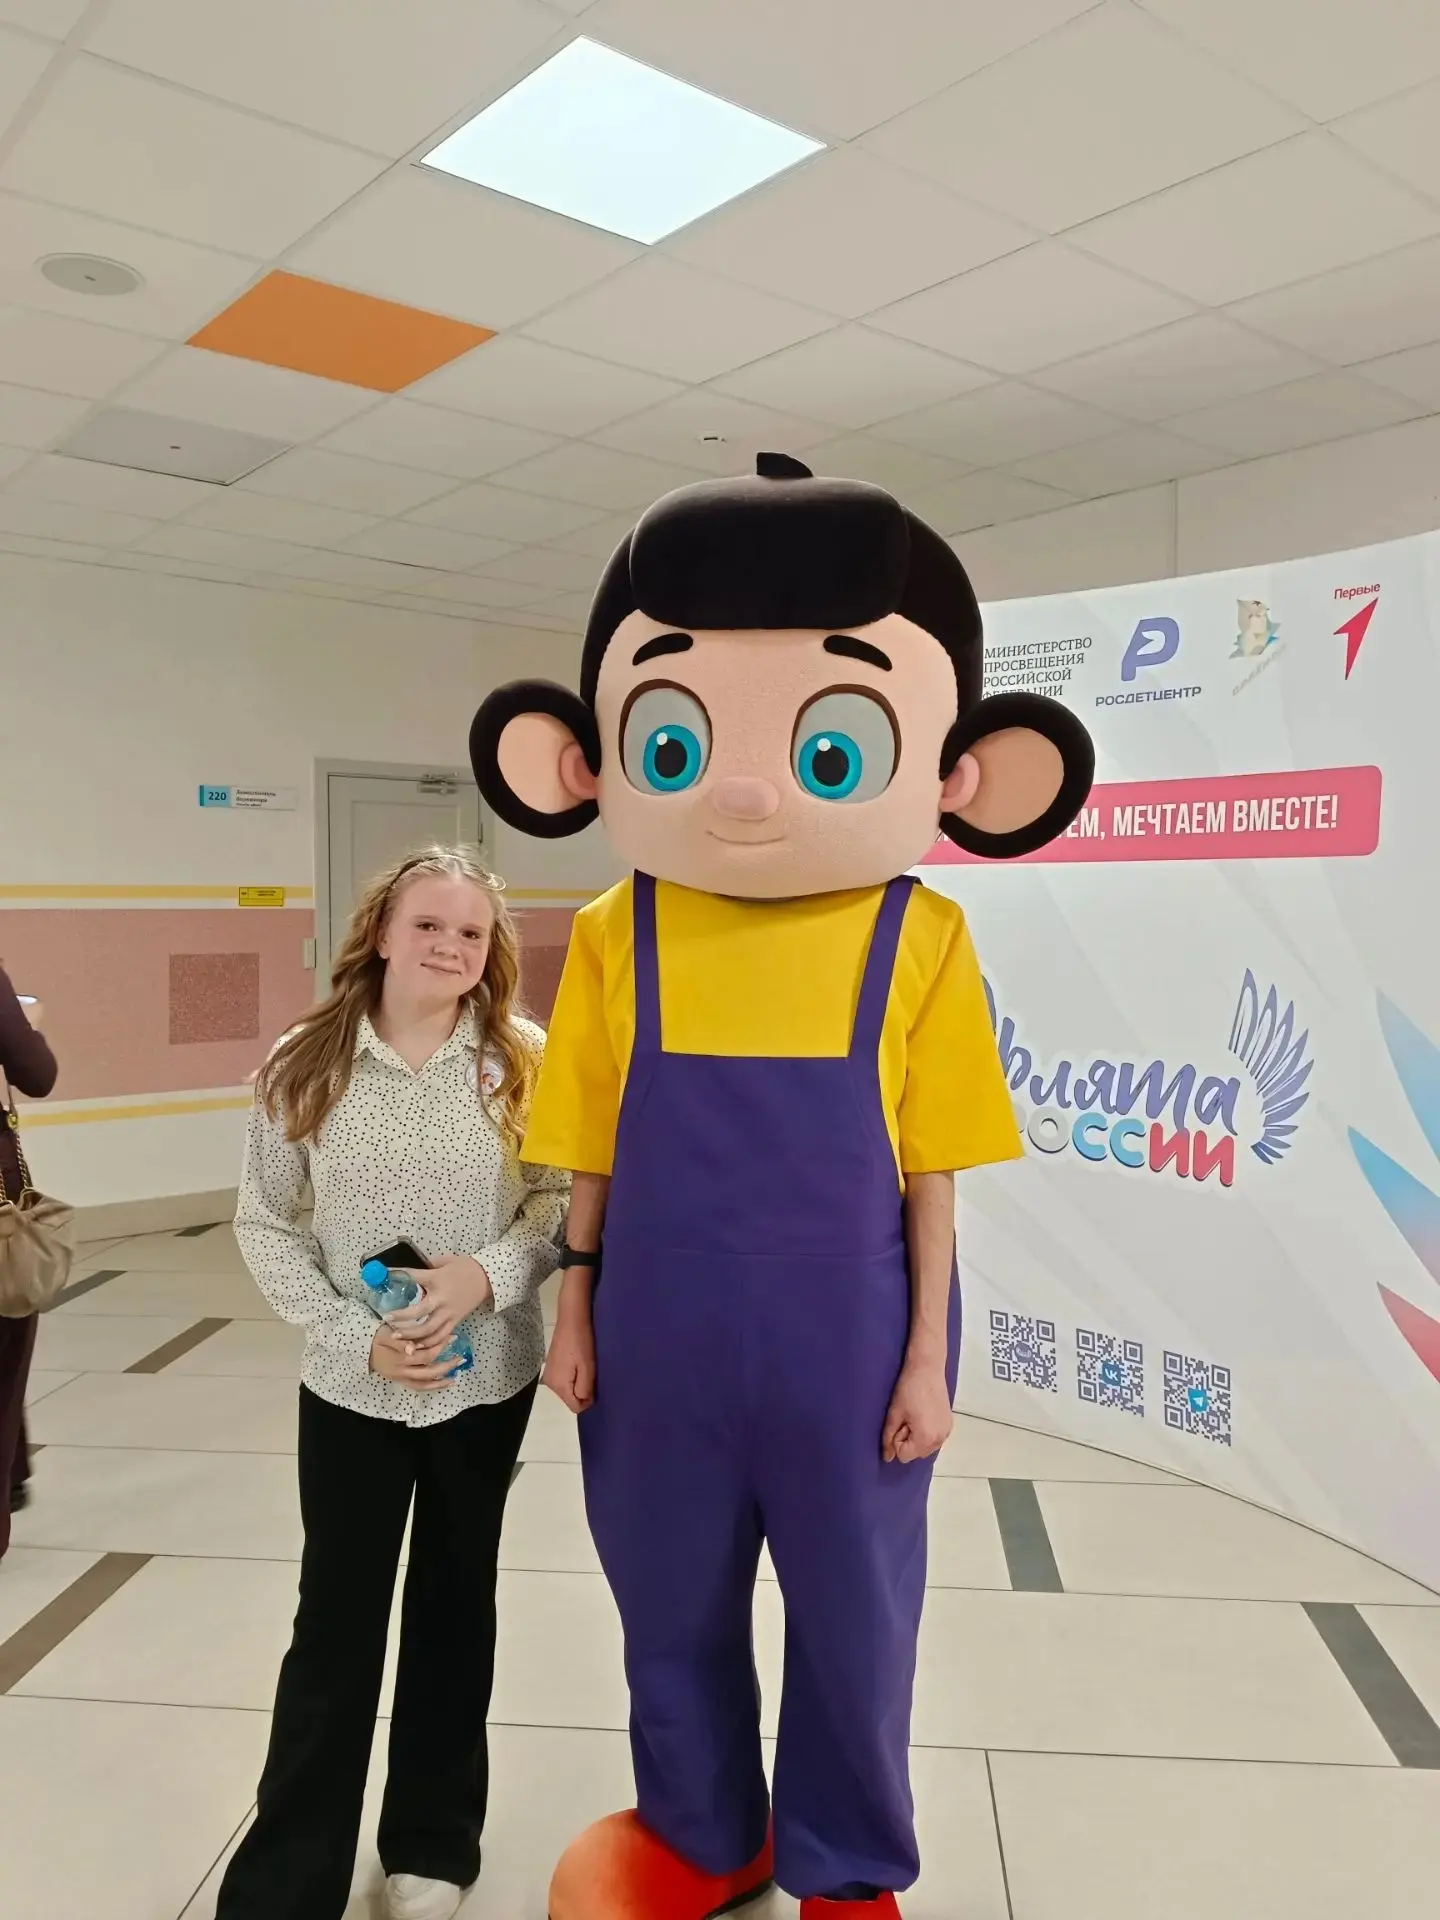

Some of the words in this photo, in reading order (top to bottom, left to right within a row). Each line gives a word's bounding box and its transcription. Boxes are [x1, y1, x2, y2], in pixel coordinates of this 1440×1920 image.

[1333, 583, 1381, 601] Первые
[984, 637, 1092, 659] МИНИСТЕРСТВО
[984, 653, 1085, 673] ПРОСВЕЩЕНИЯ
[983, 667, 1072, 688] РОССИЙСКОЙ
[1095, 686, 1202, 707] РОСДЕТЦЕНТР
[208, 791, 227, 801] 220
[1112, 801, 1226, 838] МЕЧТАЕМ
[1232, 794, 1338, 832] ВМЕСТЕ!
[982, 974, 1241, 1137] рлята
[1016, 1105, 1236, 1188] ОССИИ
